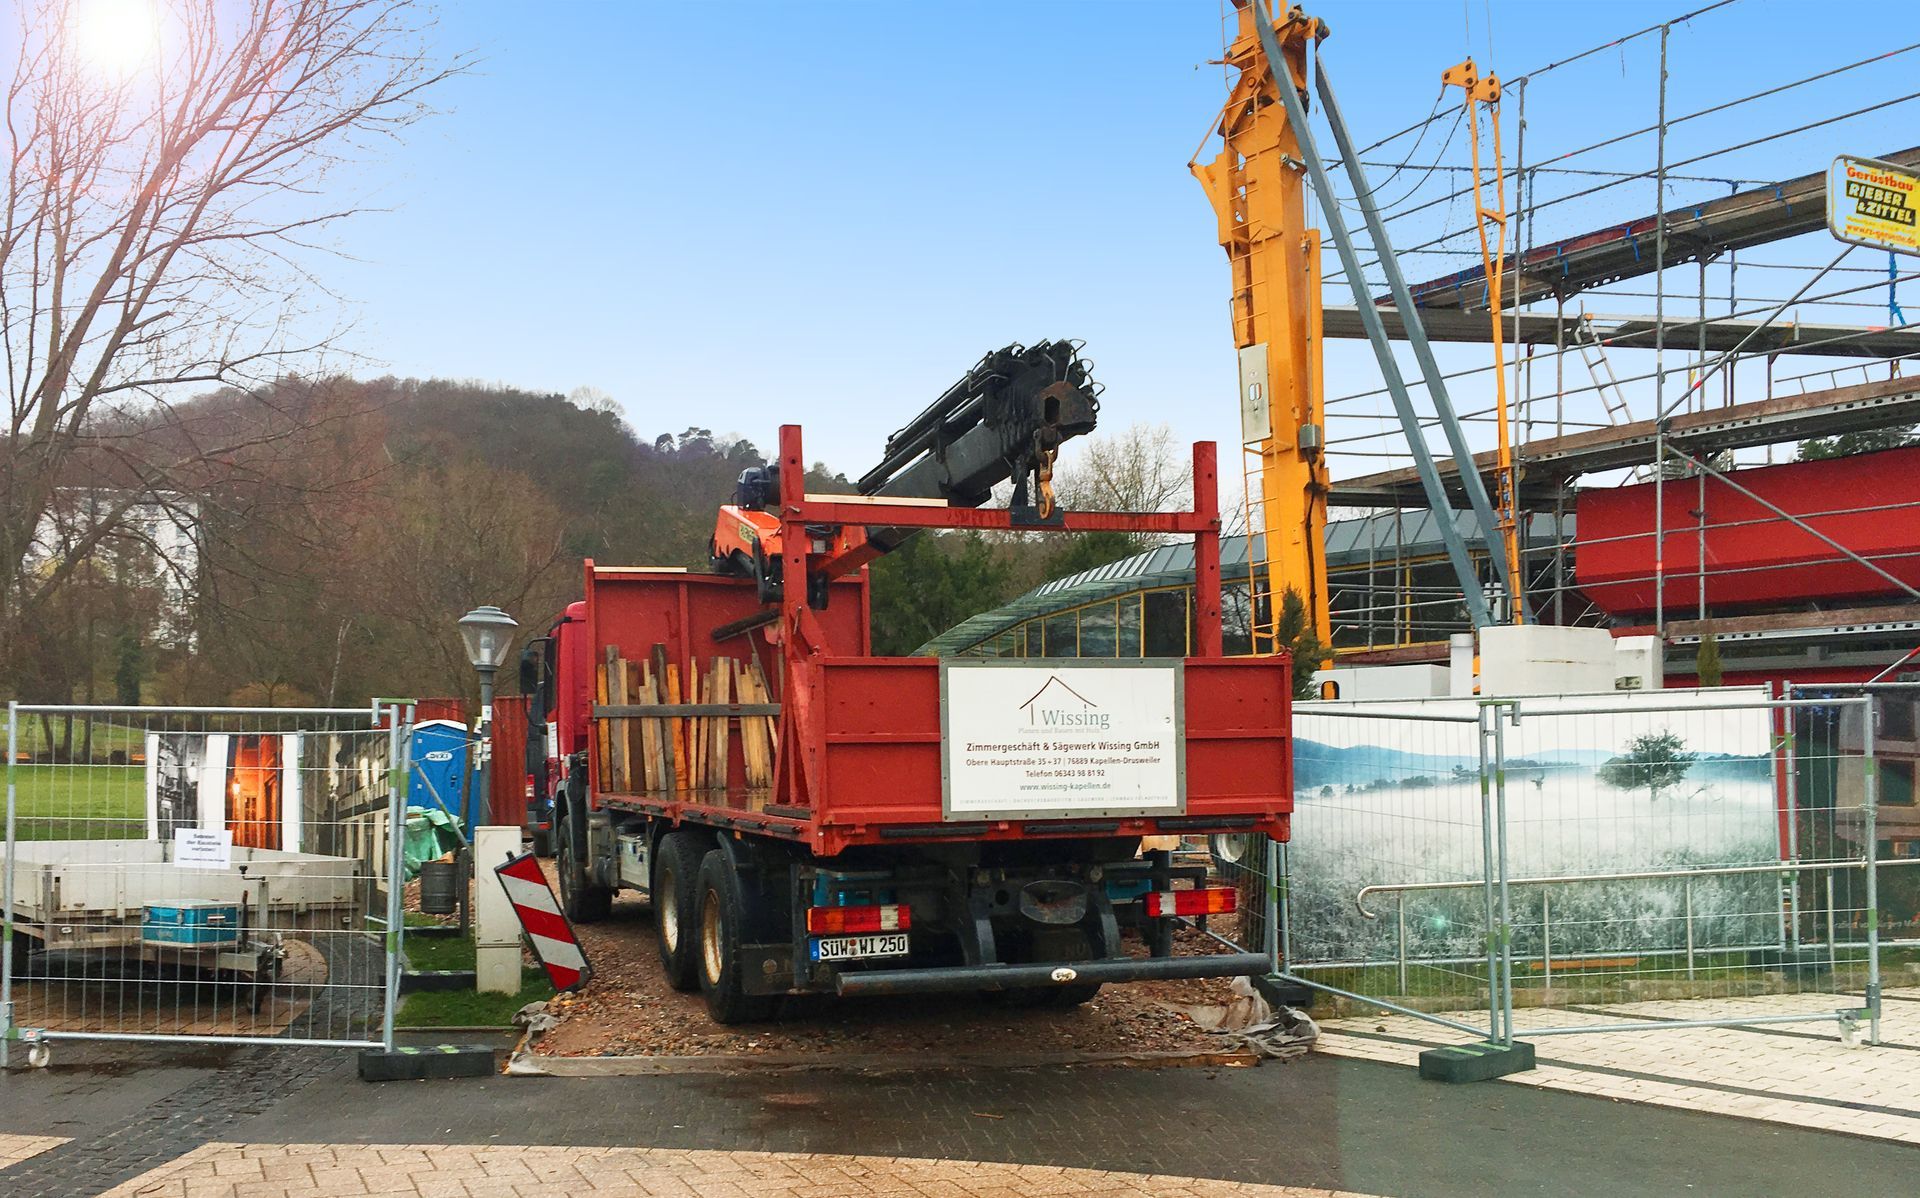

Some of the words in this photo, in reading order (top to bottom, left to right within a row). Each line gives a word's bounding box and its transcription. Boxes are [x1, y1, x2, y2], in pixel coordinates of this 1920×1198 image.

[1849, 183, 1902, 206] RIEBER
[1041, 709, 1110, 730] Wissing
[966, 742, 1041, 754] Zimmergeschäft
[1043, 742, 1049, 751] &
[1052, 741, 1096, 753] Sägewerk
[1098, 741, 1132, 752] Wissing
[1133, 740, 1160, 750] GmbH
[966, 758, 989, 767] Obere
[990, 757, 1036, 767] Hauptstraße
[1038, 757, 1047, 766] 35
[1053, 757, 1062, 765] 37
[1067, 757, 1089, 765] 76889
[1090, 756, 1161, 766] Kapellen-Drusweiler
[1026, 770, 1053, 778] Telefon
[1054, 769, 1076, 777] 06343
[1019, 782, 1111, 792] www.wissing-kapellen.de
[821, 939, 848, 957] SÜW
[860, 938, 876, 954] WI
[879, 936, 906, 953] 250
